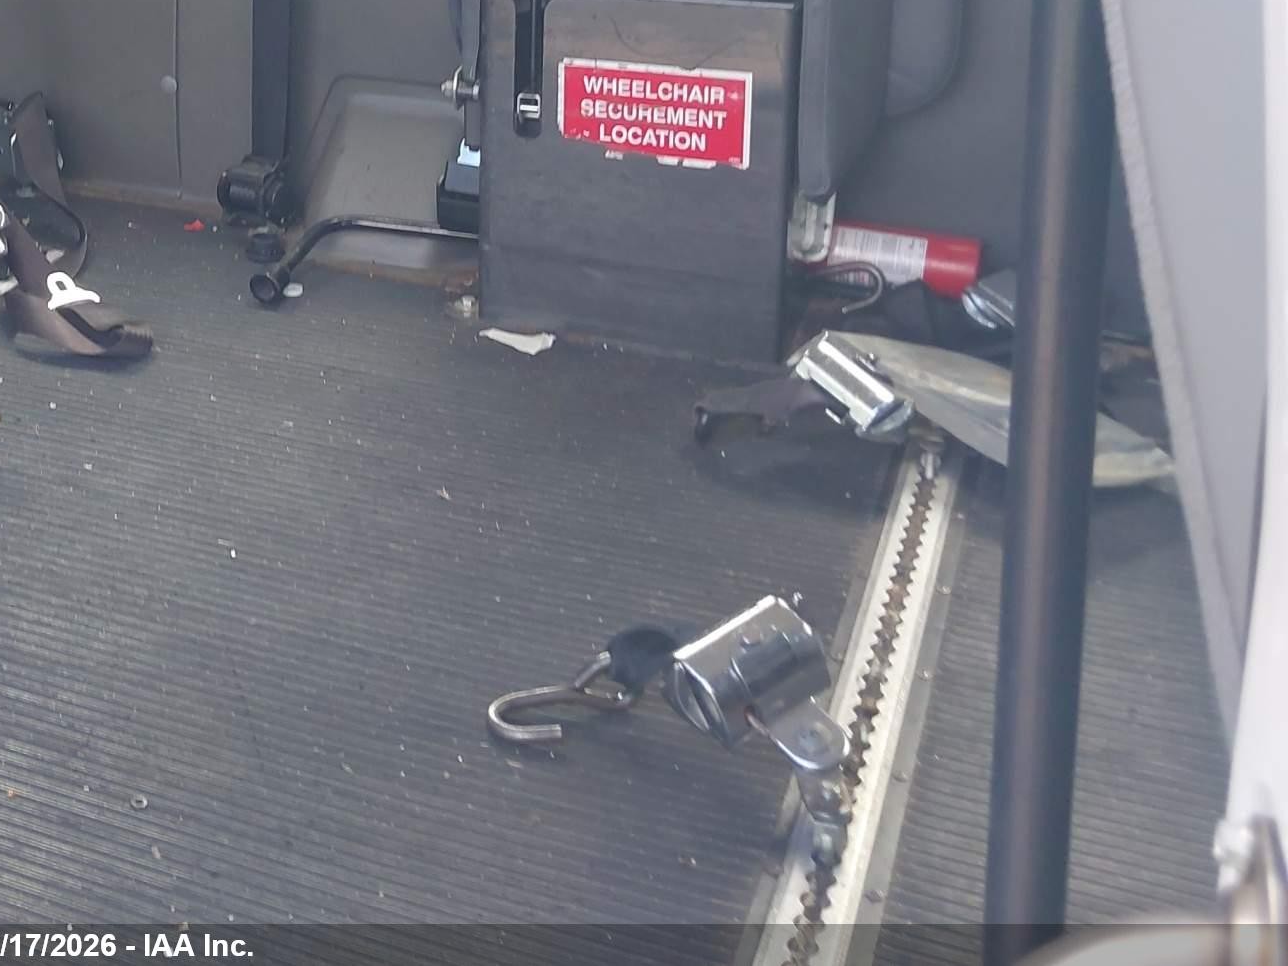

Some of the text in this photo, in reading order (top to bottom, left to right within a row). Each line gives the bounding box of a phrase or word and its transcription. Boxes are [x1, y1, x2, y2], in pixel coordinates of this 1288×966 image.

[583, 75, 725, 105] WHEELCHAIR
[580, 98, 727, 130] SECUREMENT
[599, 123, 706, 152] LOCATION
